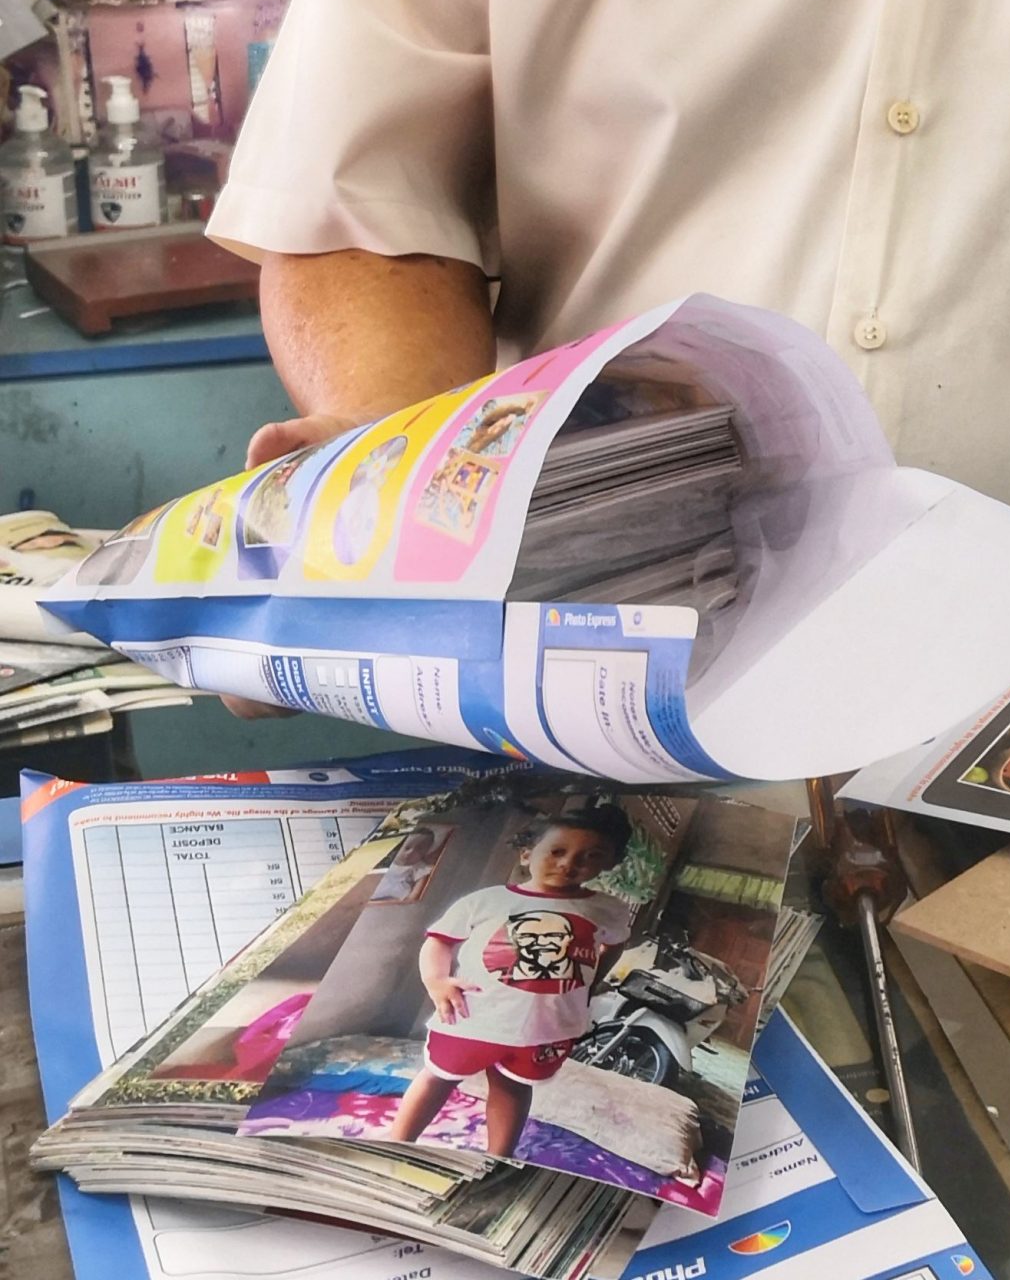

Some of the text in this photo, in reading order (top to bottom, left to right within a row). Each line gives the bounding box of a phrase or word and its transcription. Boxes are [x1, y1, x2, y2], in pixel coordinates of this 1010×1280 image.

[564, 612, 617, 630] Photo Express
[362, 668, 378, 714] INPUT
[169, 823, 224, 835] BALANCE
[172, 837, 222, 848] DEPOSIT
[173, 852, 210, 860] TOTAL
[735, 1138, 804, 1170] Address:
[769, 1154, 818, 1178] Name:
[393, 1244, 424, 1259] Tel:
